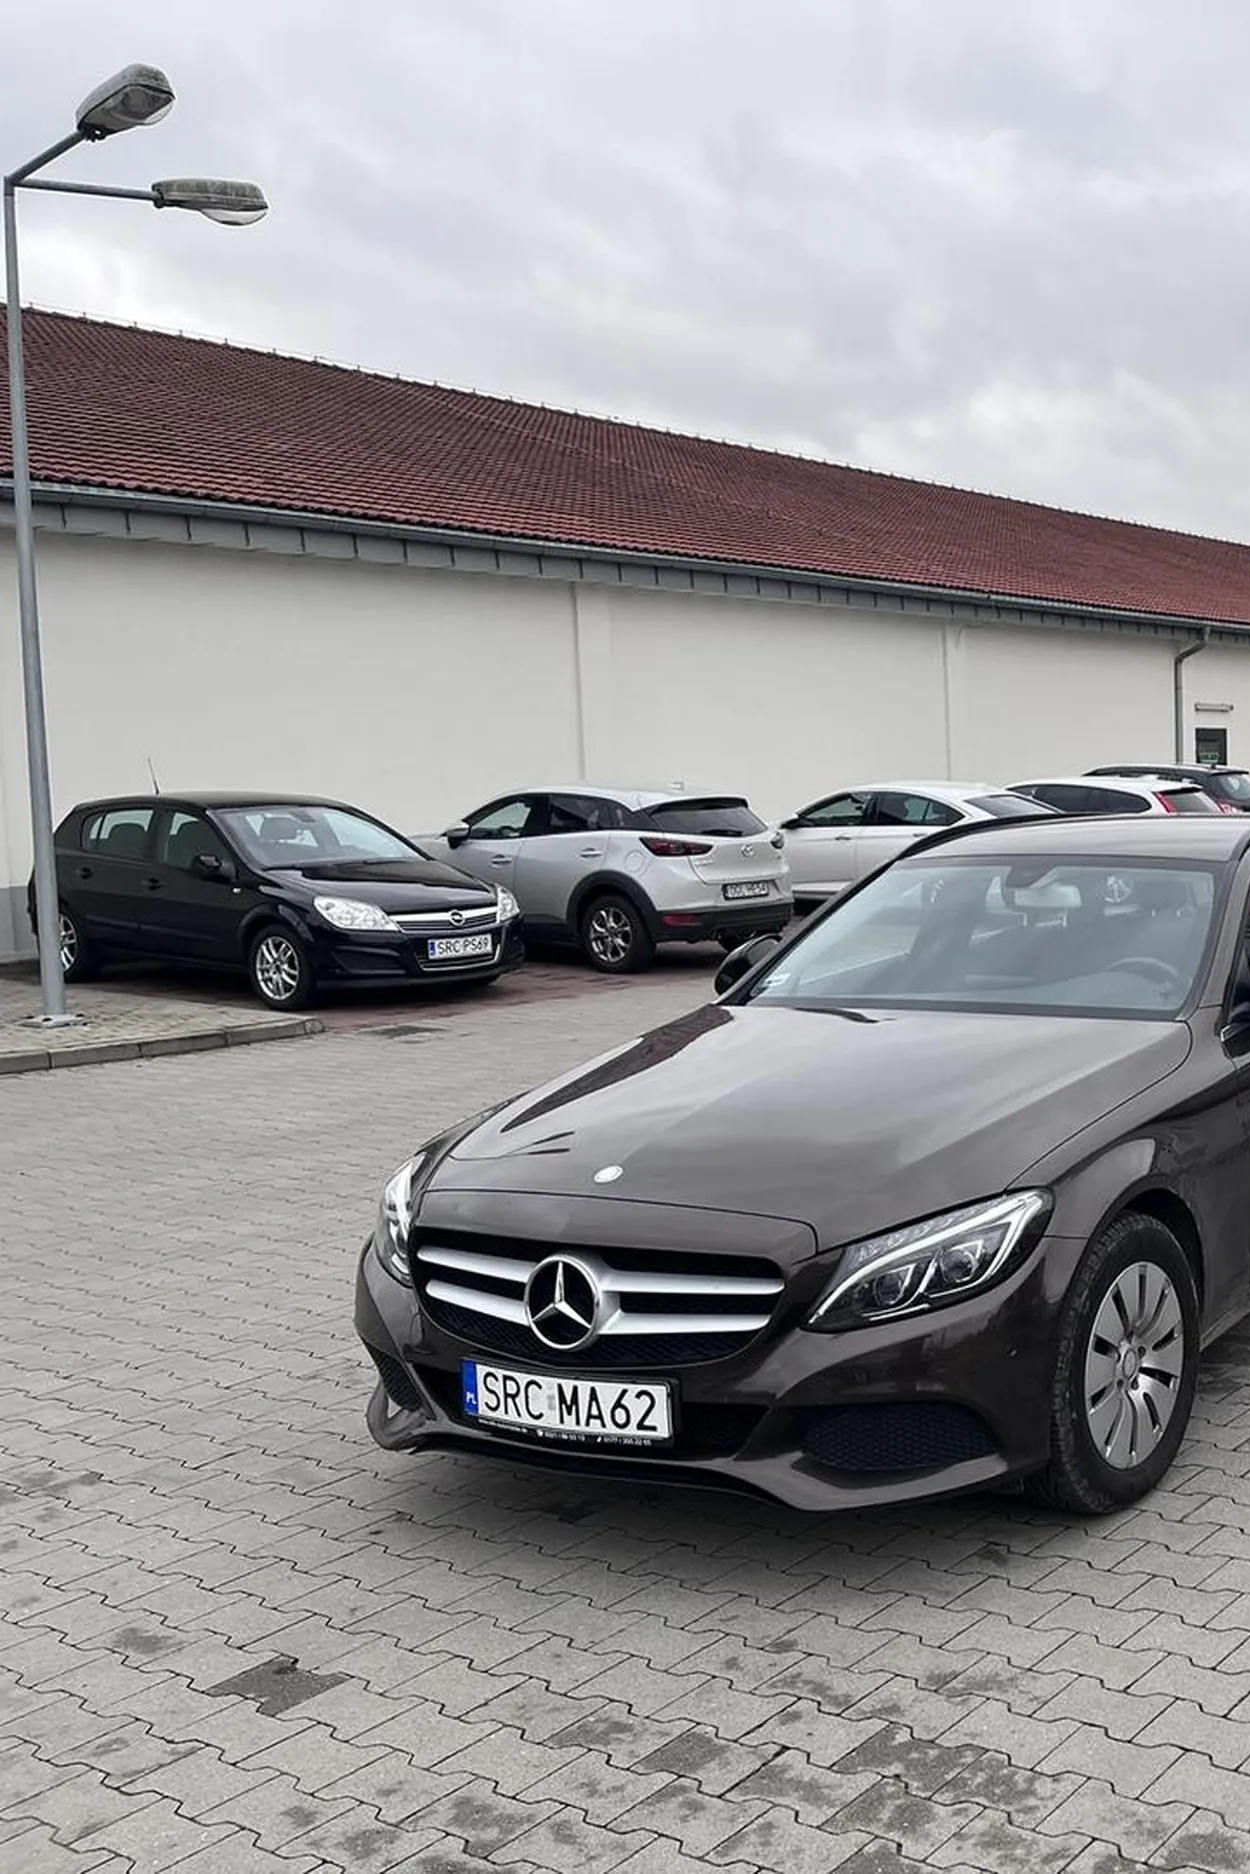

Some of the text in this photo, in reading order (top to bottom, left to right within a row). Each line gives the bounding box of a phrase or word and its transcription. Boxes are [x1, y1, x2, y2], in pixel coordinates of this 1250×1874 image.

[437, 937, 489, 955] SRC PS69
[483, 1372, 544, 1420] SRC
[557, 1383, 658, 1432] MA62
